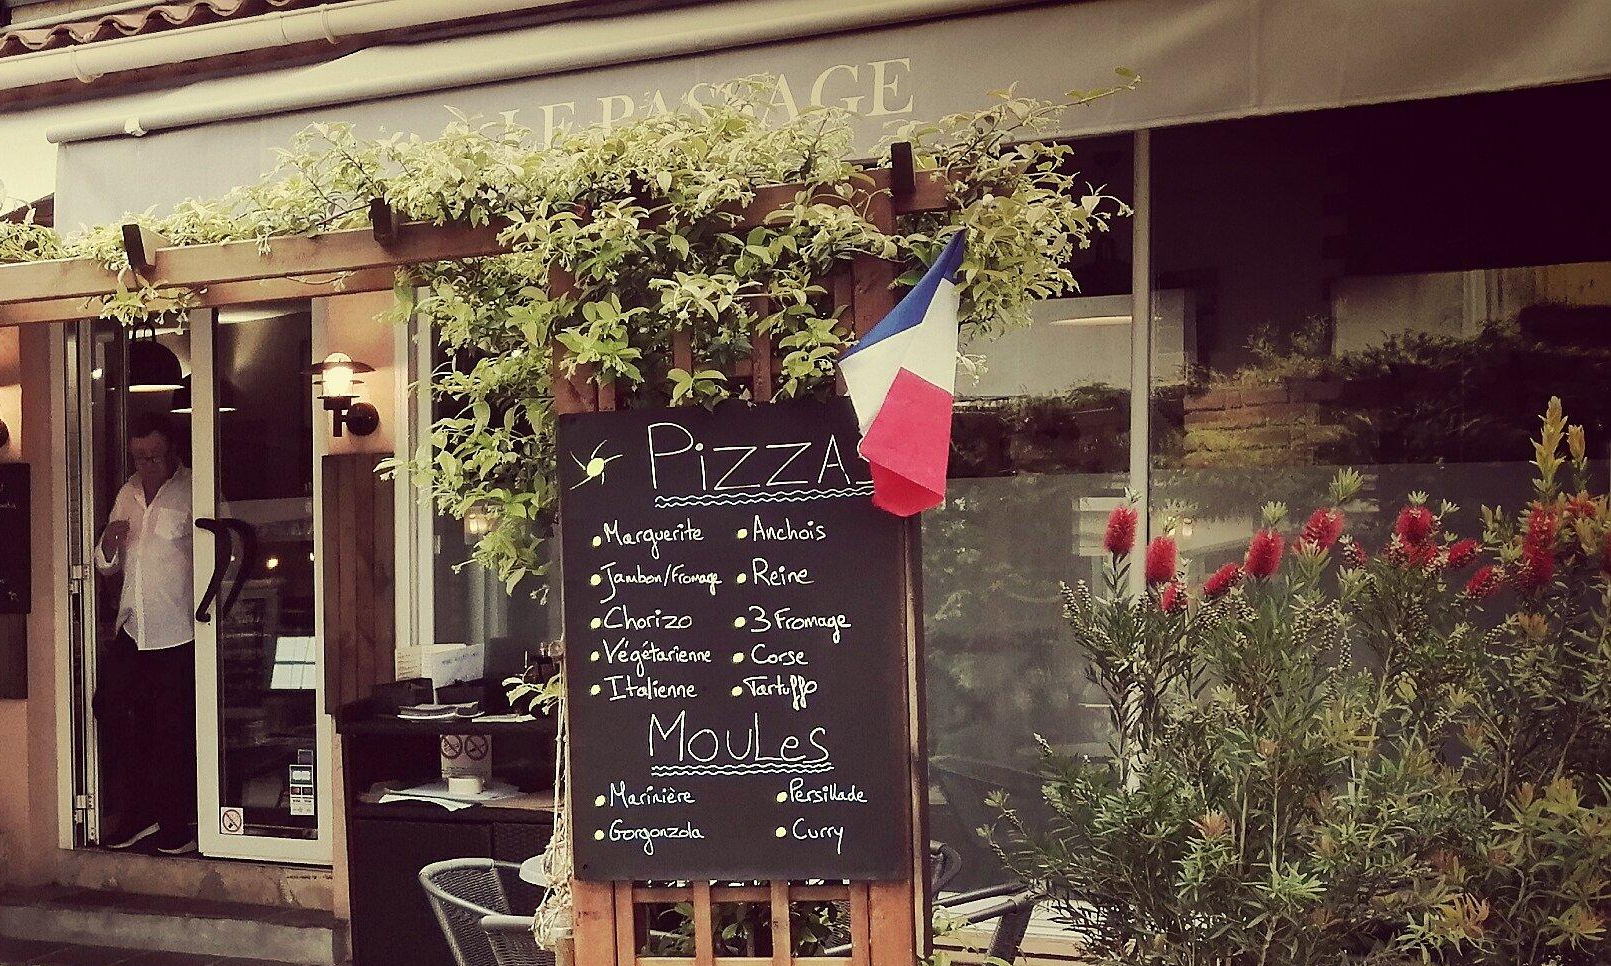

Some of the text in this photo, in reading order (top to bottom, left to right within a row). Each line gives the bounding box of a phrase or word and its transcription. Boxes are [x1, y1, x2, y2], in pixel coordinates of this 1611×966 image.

[603, 519, 705, 559] Marguerite
[752, 514, 827, 542] Anchois
[751, 558, 814, 587] Reine
[603, 606, 693, 630] Chorizo
[748, 606, 852, 644] 3 Fromage
[603, 637, 713, 678] Végétarienne
[750, 643, 809, 666] Corse
[604, 676, 698, 701] Italienne
[609, 781, 696, 810] Marinière
[790, 778, 868, 802] Persillade
[609, 819, 704, 856] Gorgonzola
[792, 818, 844, 855] Curry
